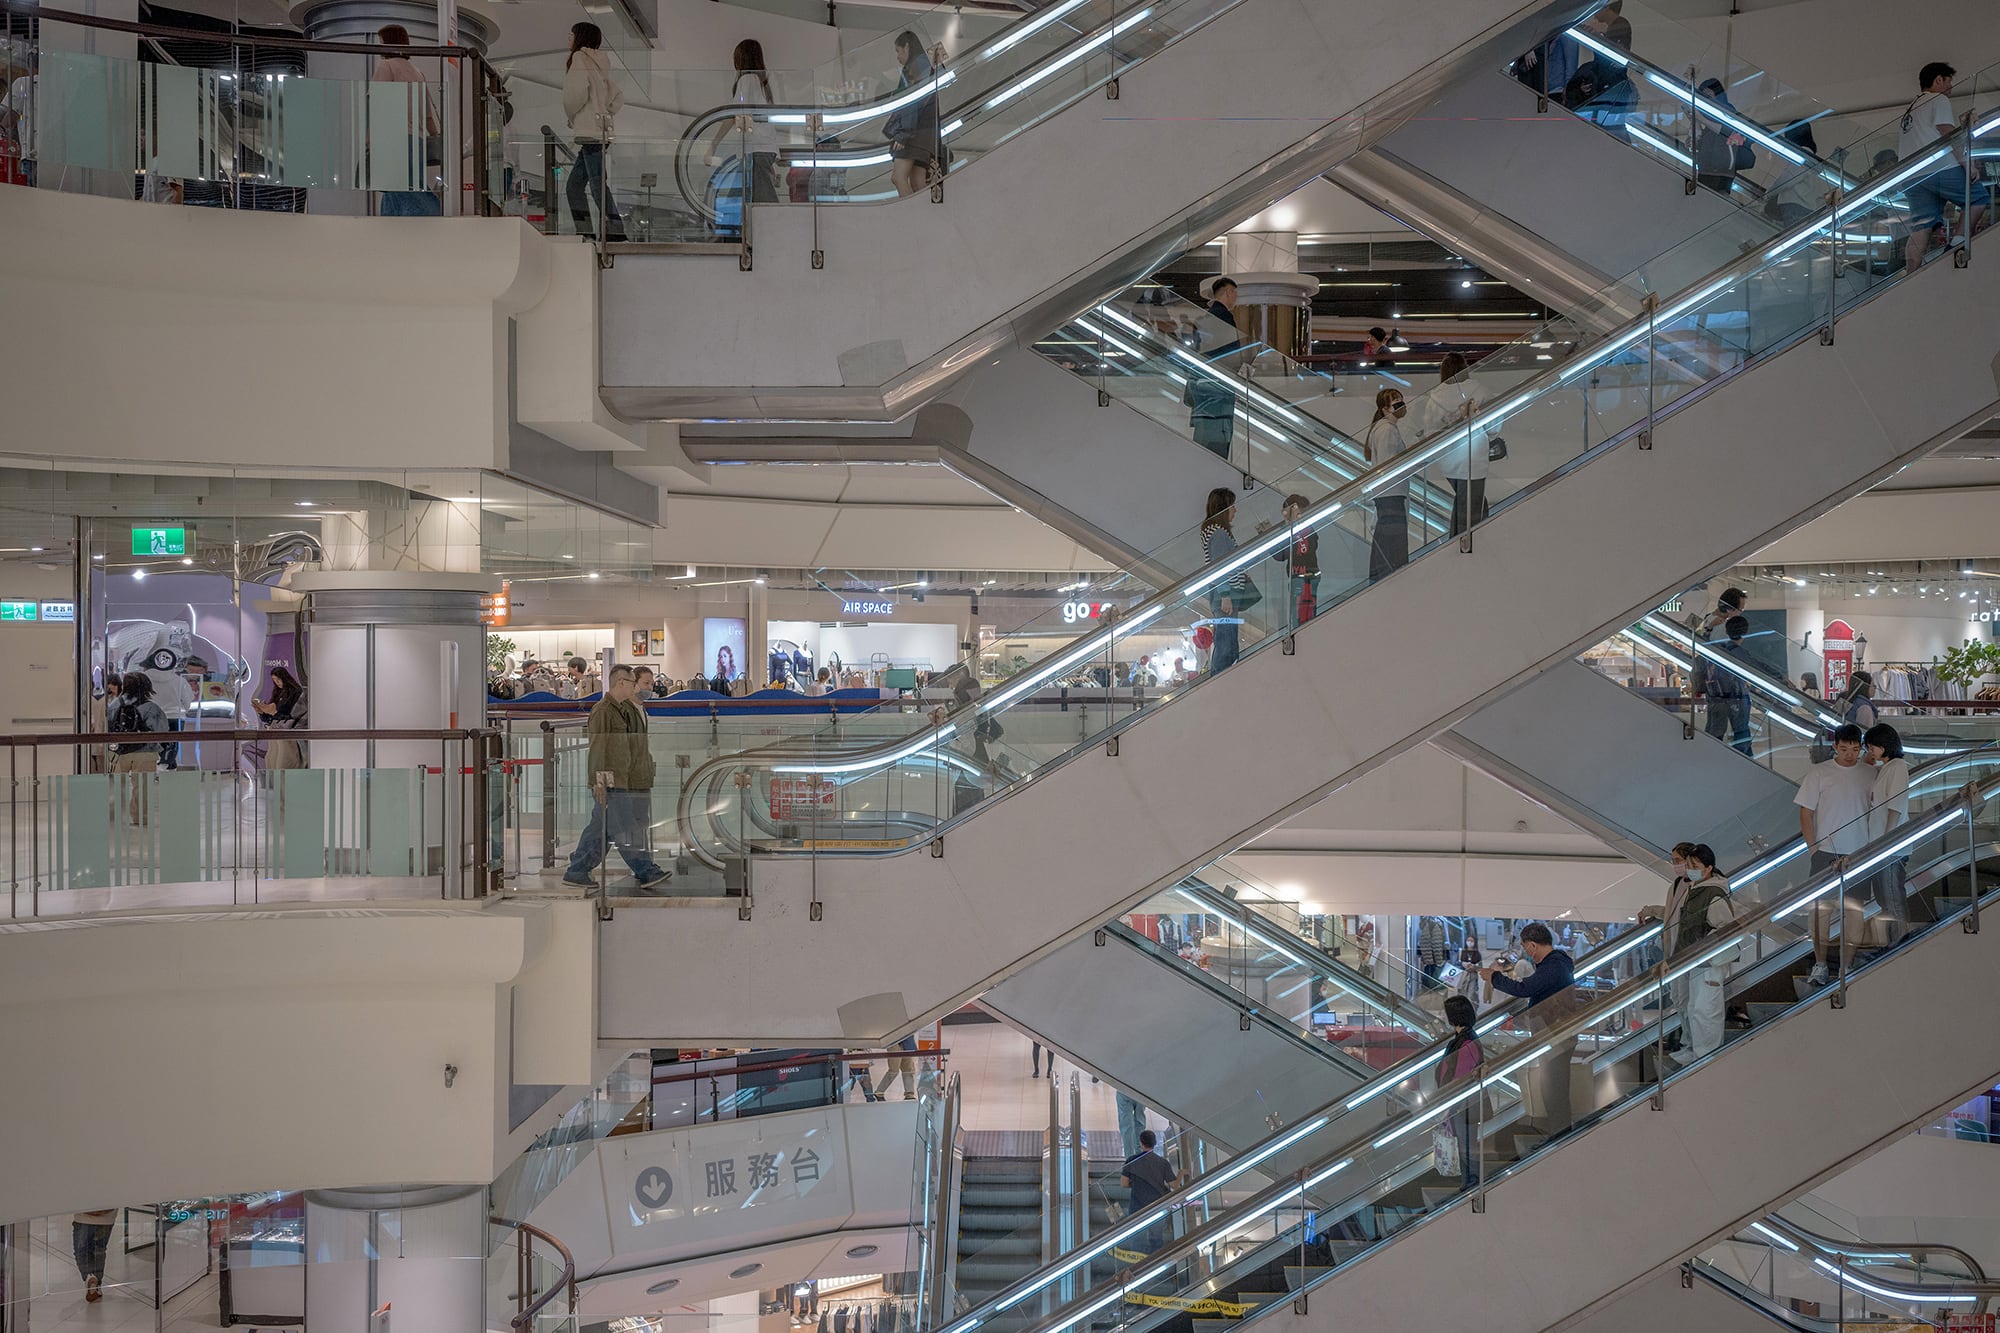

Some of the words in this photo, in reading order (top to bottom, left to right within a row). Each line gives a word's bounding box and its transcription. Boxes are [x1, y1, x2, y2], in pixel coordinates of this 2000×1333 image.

[844, 602, 861, 613] AIR
[863, 602, 893, 614] SPACE
[705, 1147, 820, 1198] 服務台
